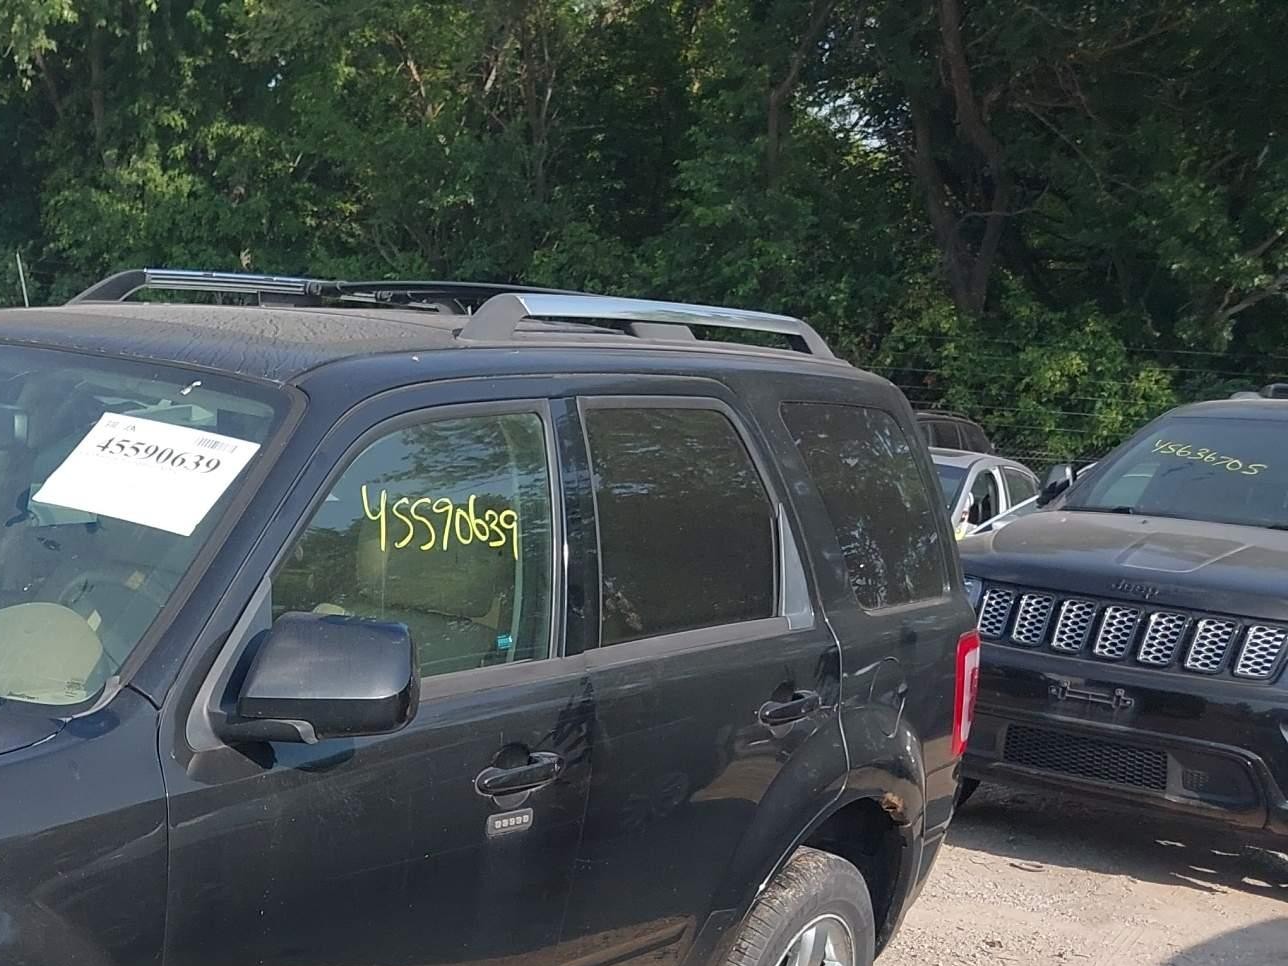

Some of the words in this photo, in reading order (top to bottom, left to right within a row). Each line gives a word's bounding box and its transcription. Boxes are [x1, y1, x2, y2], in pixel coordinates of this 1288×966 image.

[95, 437, 221, 474] 45590639
[1152, 439, 1268, 475] 45636705
[361, 485, 519, 561] 45590639
